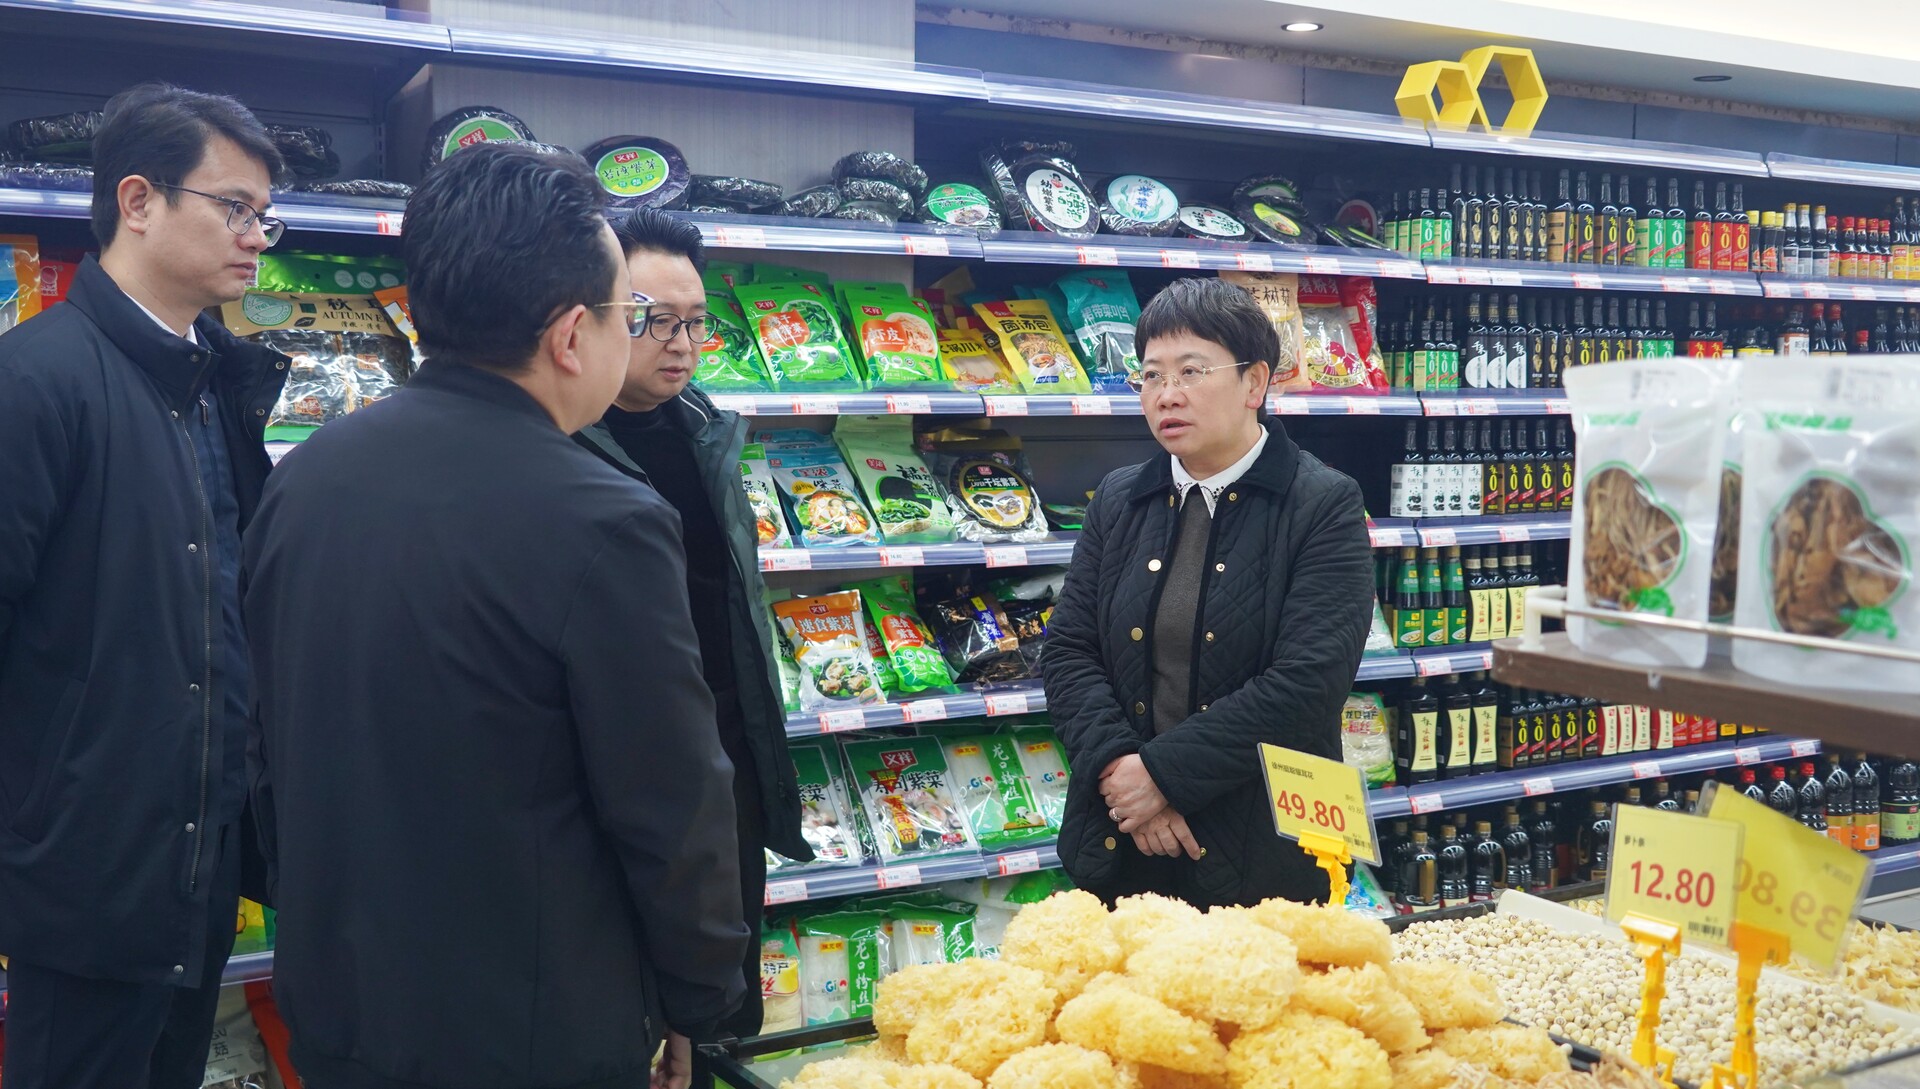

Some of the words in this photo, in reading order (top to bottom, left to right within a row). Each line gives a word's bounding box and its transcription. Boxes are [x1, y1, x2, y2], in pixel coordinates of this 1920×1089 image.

[461, 130, 485, 147] 义祥
[617, 152, 636, 162] 义祥
[757, 301, 775, 309] 义祥
[864, 307, 880, 315] 义祥
[323, 311, 373, 321] AUTUMN
[999, 319, 1052, 333] 菌汤包
[799, 615, 854, 633] 速食紫菜
[885, 752, 912, 766] 义祥
[1277, 790, 1345, 832] 49.80
[1631, 860, 1715, 907] 12.80
[855, 939, 873, 1008] 龙口粉丝
